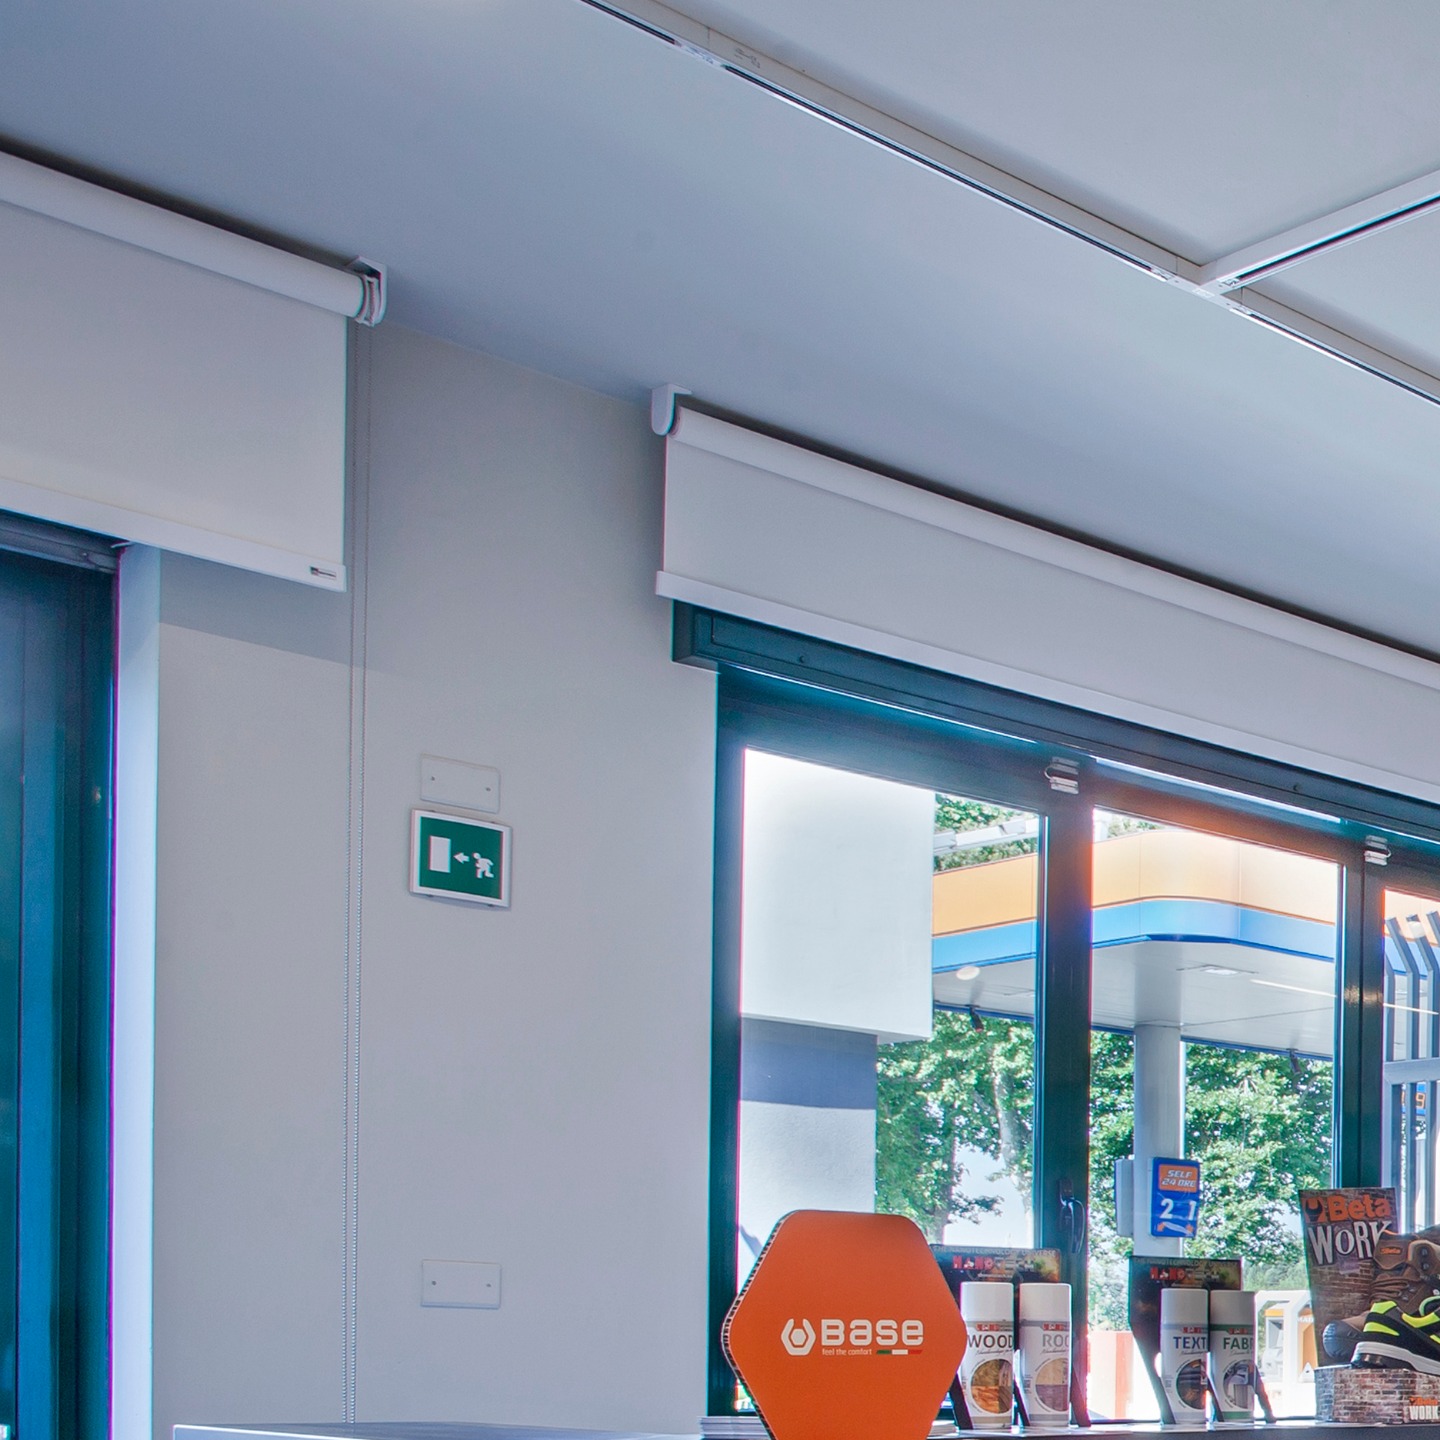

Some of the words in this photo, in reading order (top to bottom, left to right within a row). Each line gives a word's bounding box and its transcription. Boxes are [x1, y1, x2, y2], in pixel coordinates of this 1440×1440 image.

[1167, 1170, 1193, 1178] SELF
[1160, 1198, 1174, 1219] 2
[1329, 1194, 1392, 1221] Beta
[821, 1348, 834, 1356] feel
[836, 1348, 846, 1356] the
[848, 1348, 872, 1356] comfort
[1410, 1405, 1440, 1420] WORK
